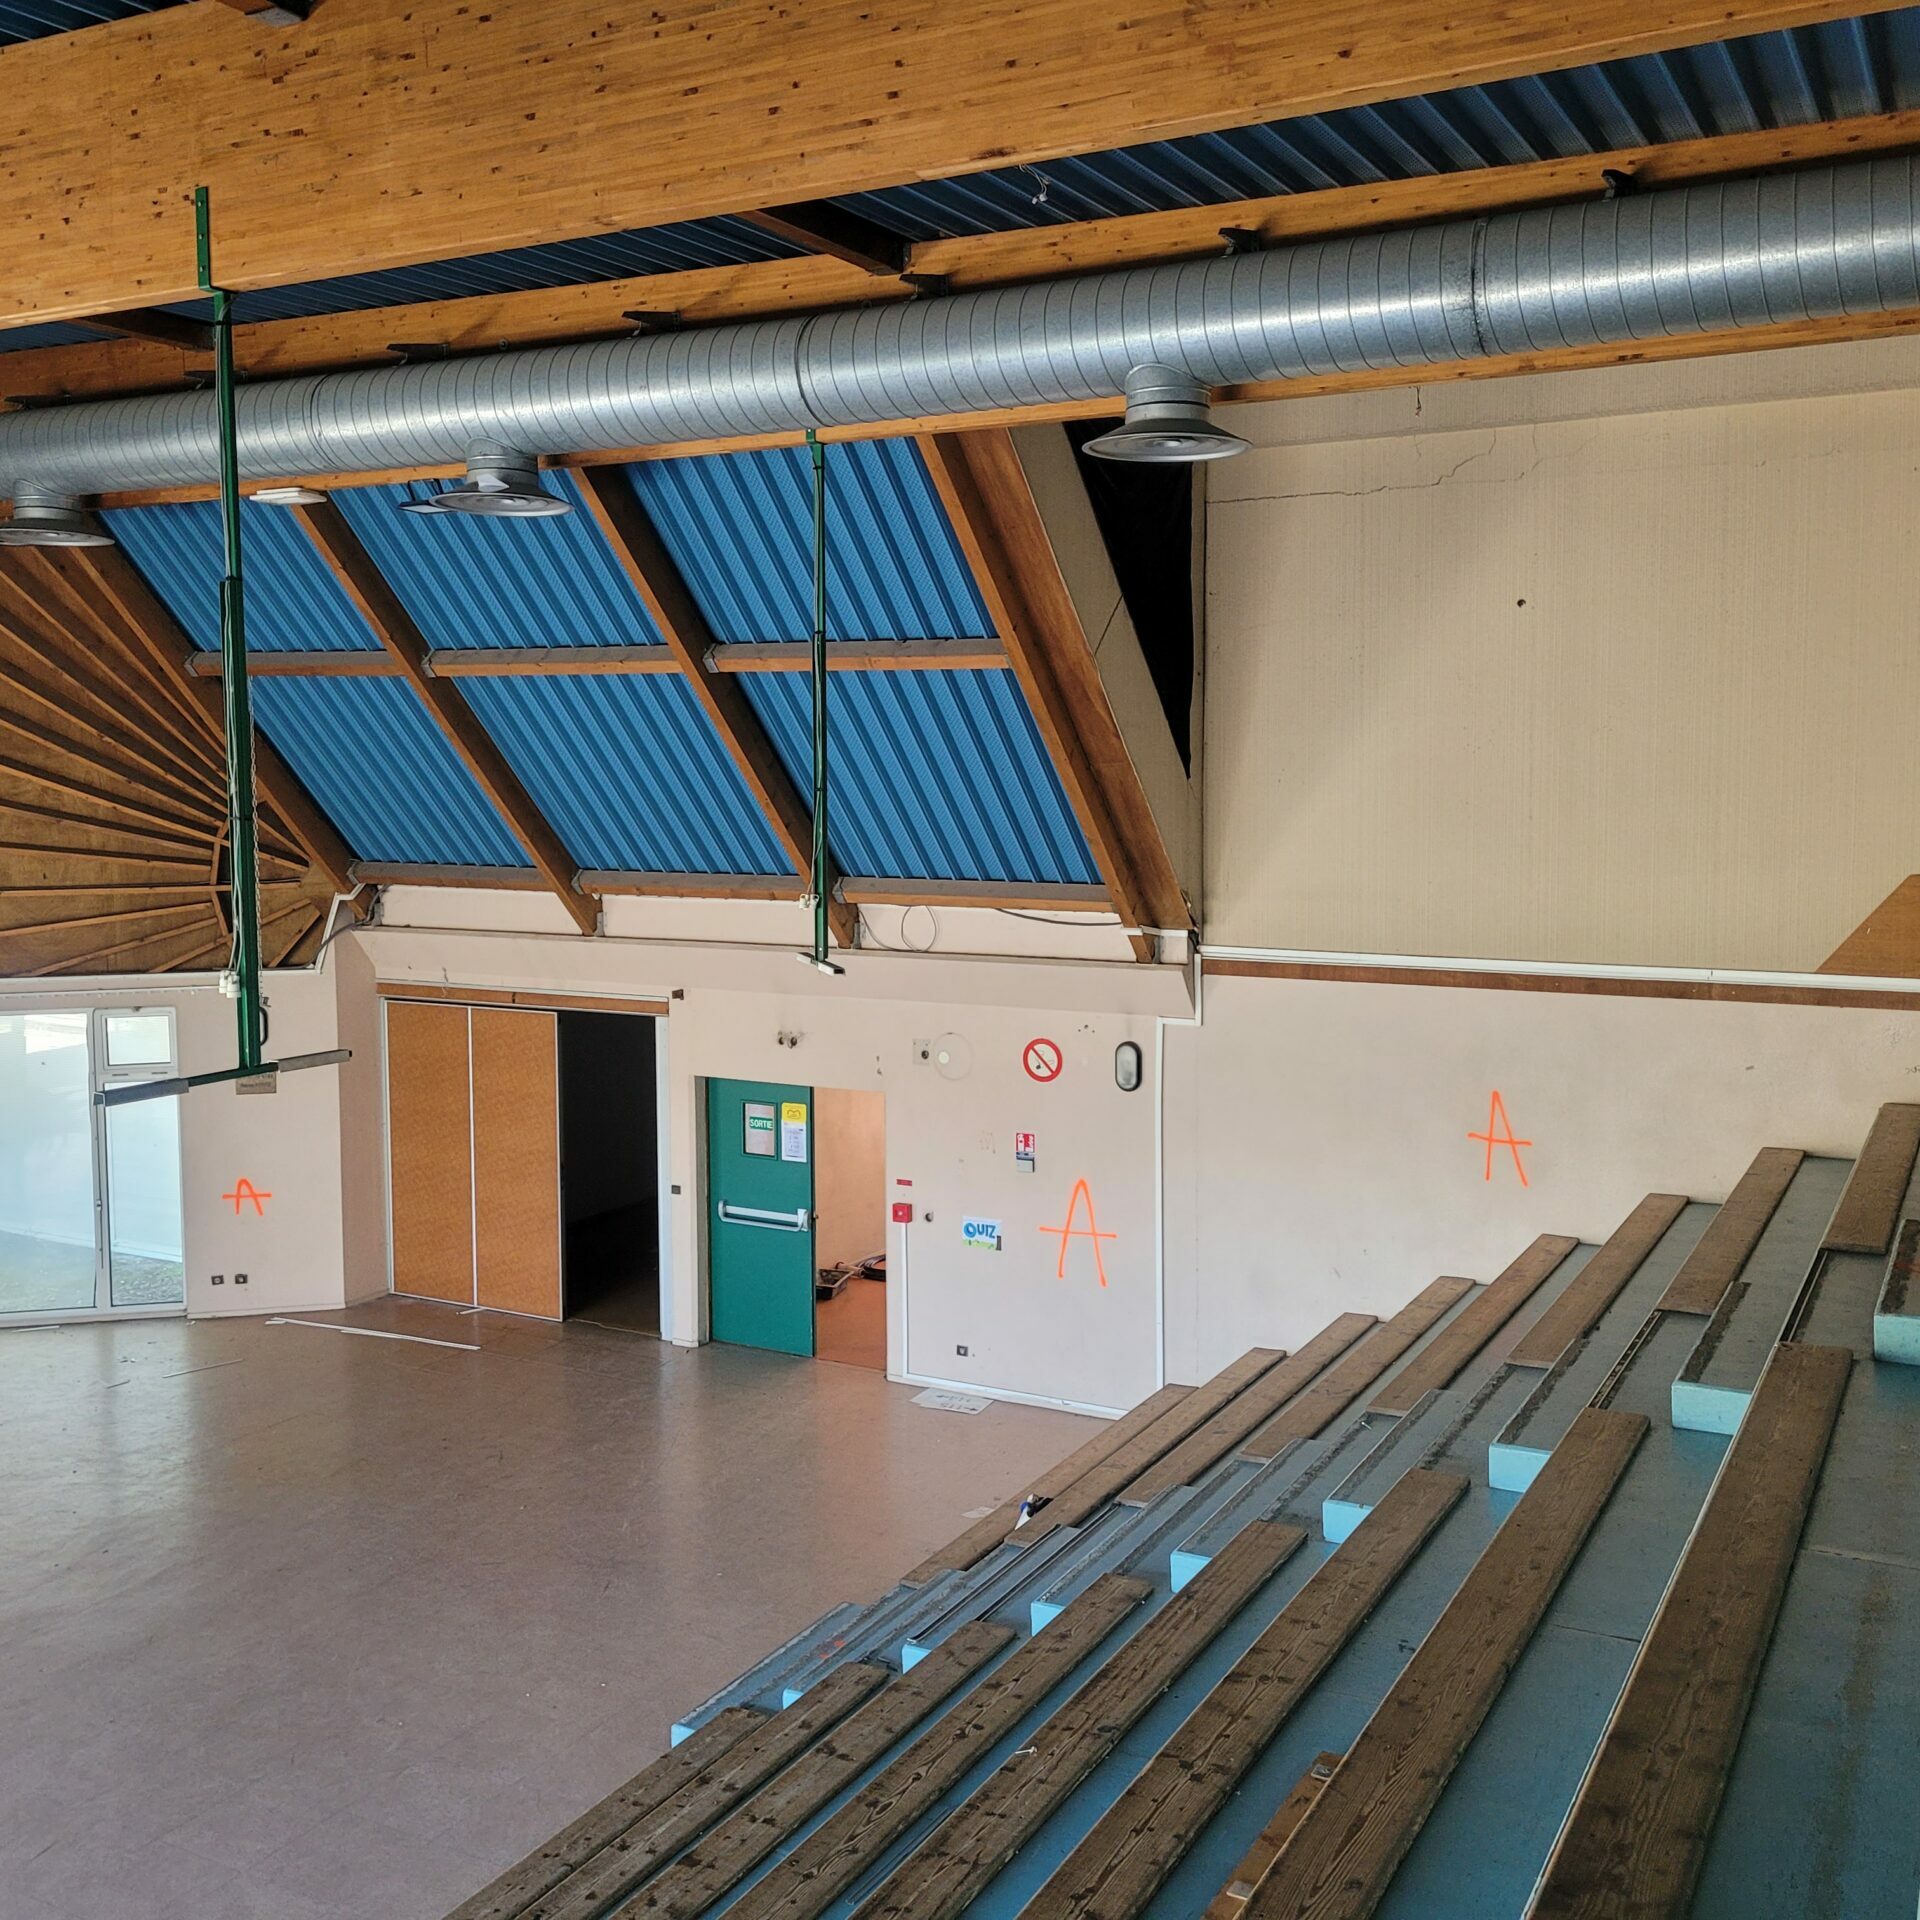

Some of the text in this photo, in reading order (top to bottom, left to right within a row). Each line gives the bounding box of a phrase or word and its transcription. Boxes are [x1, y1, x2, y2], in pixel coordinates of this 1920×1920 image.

[750, 1118, 773, 1129] SORTIE
[1467, 1089, 1533, 1188] A
[1039, 1178, 1117, 1288] A
